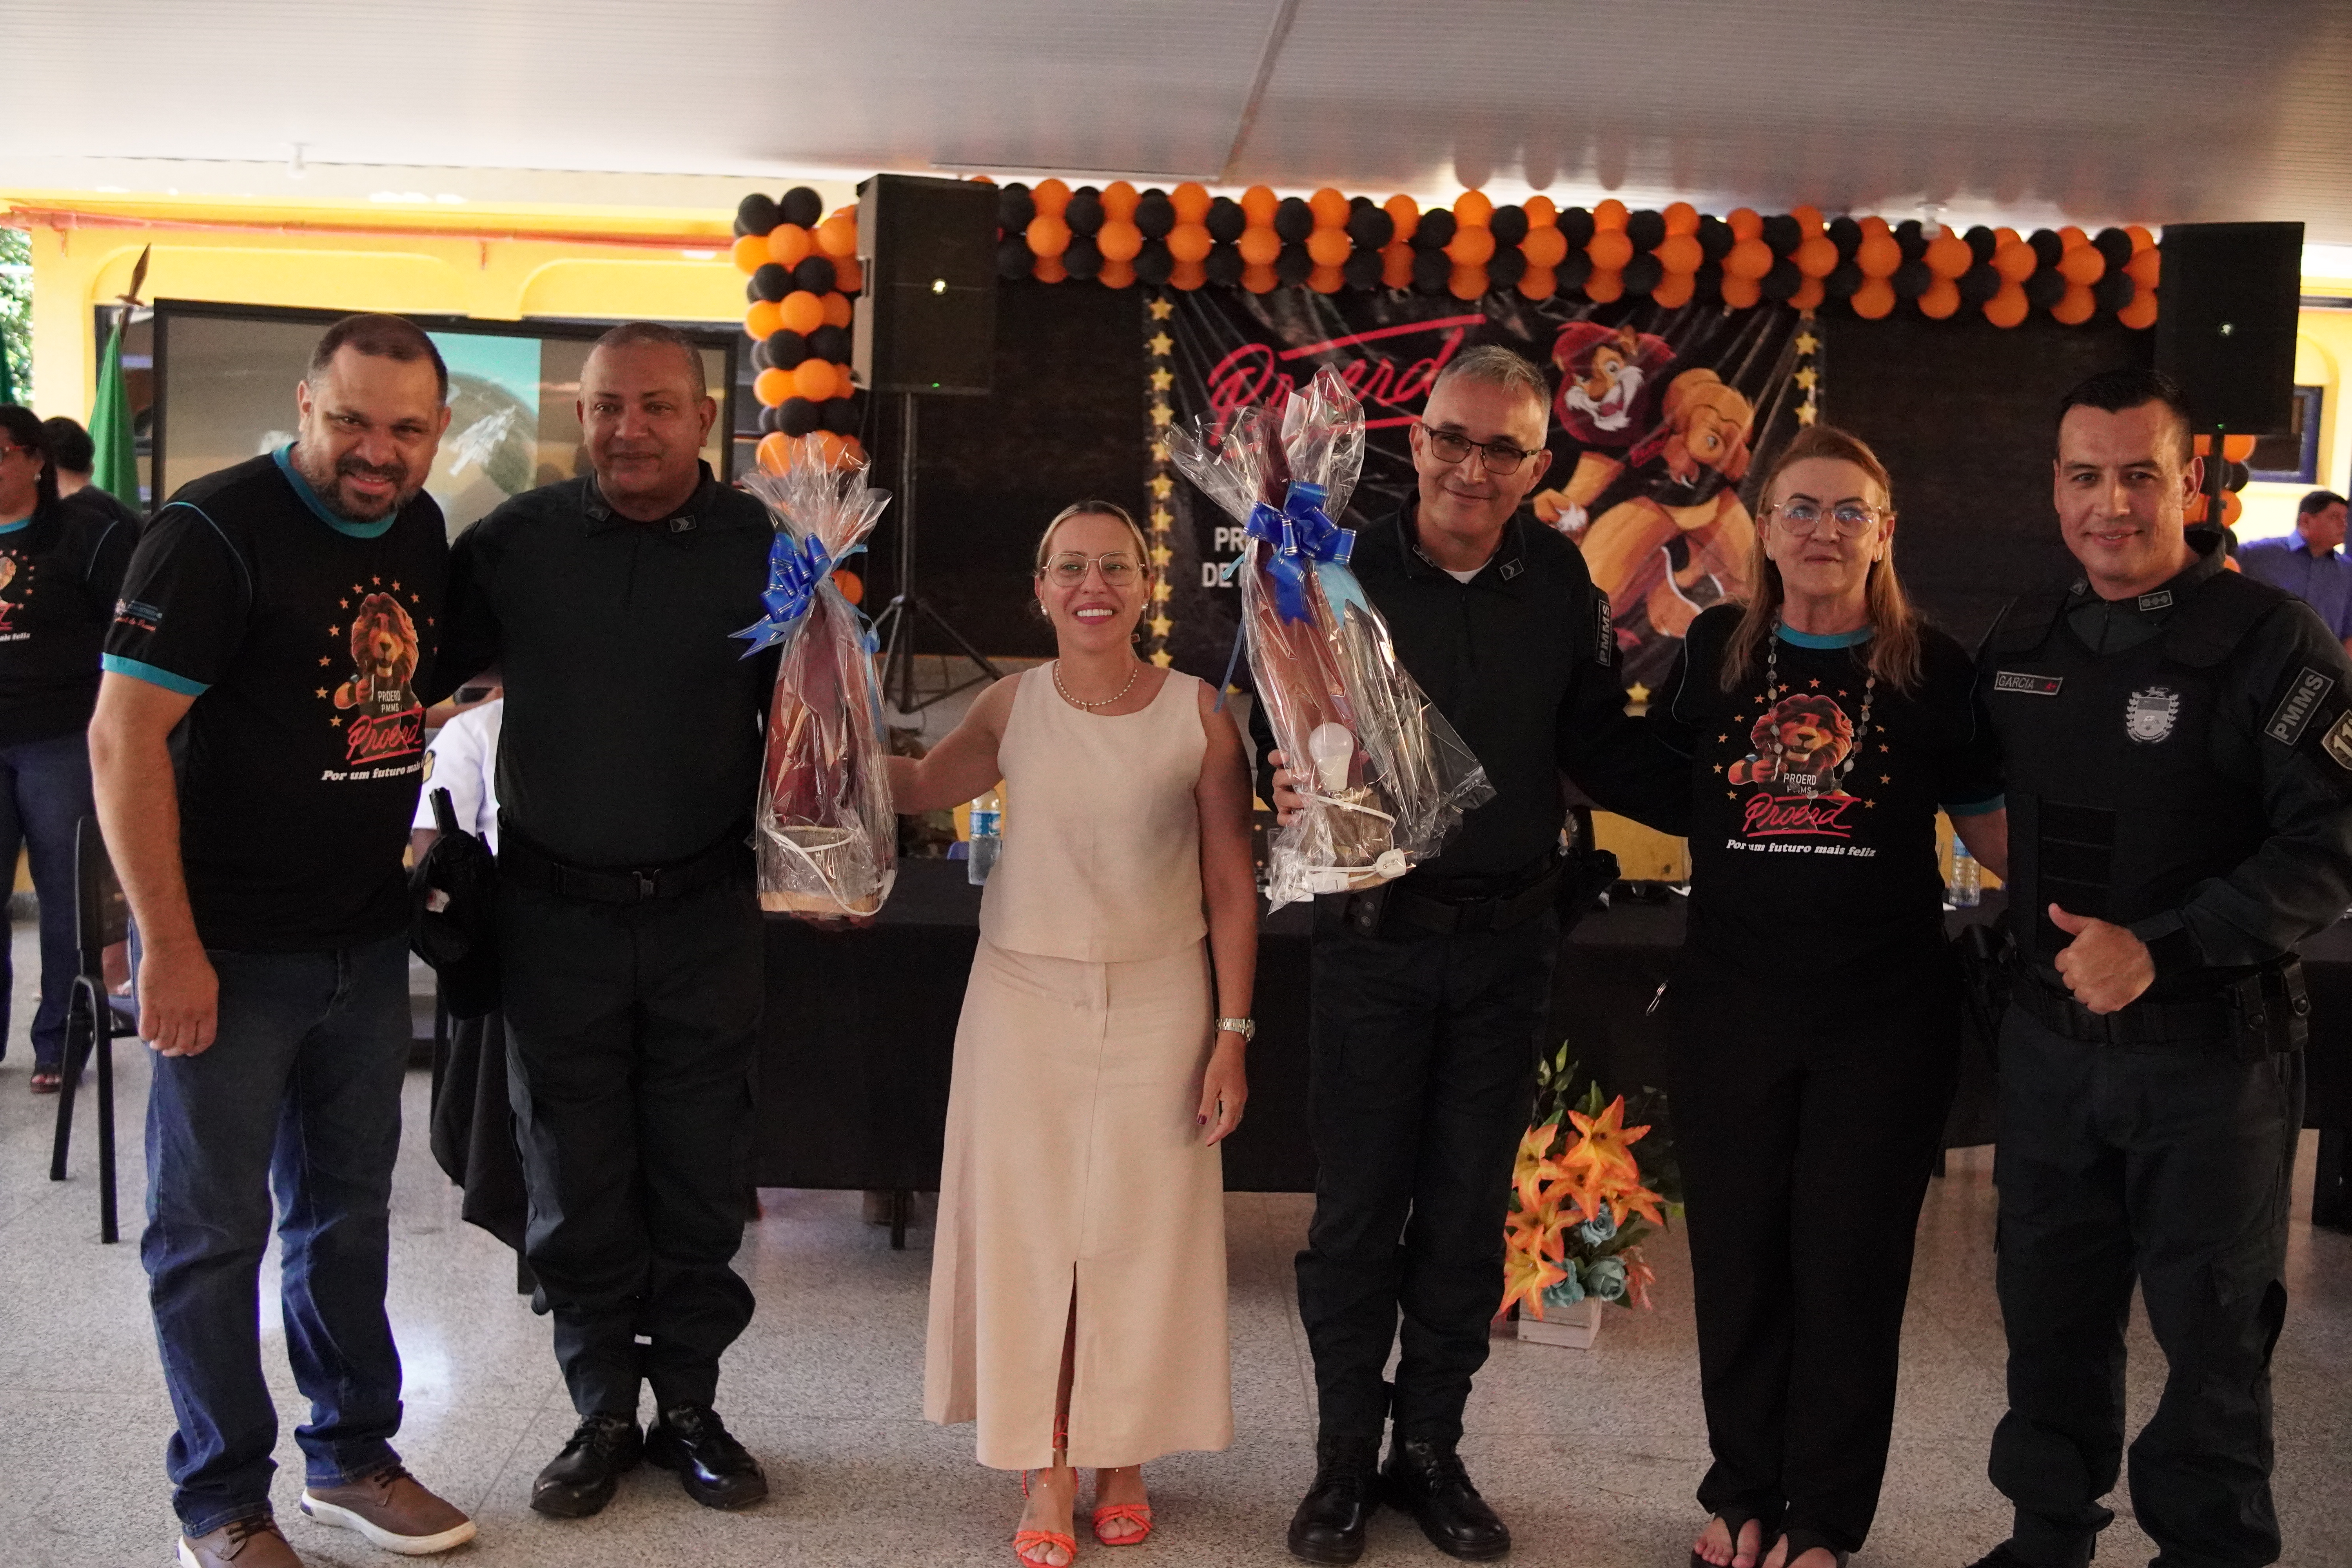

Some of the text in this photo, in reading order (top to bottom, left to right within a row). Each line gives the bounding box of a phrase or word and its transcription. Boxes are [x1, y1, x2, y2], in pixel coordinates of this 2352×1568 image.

[1208, 327, 1465, 446] Prerd
[1599, 604, 1610, 663] PMMS
[1999, 675, 2034, 690] GARCIA
[378, 690, 401, 702] PROERD
[381, 703, 399, 713] PMMS
[2273, 674, 2324, 740] PMMS
[346, 708, 423, 760] Proerd
[321, 770, 348, 780] Por
[350, 771, 370, 780] um
[372, 766, 406, 779] futuro
[1783, 773, 1817, 786] PROERD
[1742, 793, 1853, 832] Proerd
[1726, 839, 1877, 857] Por um futuro mais feliz
